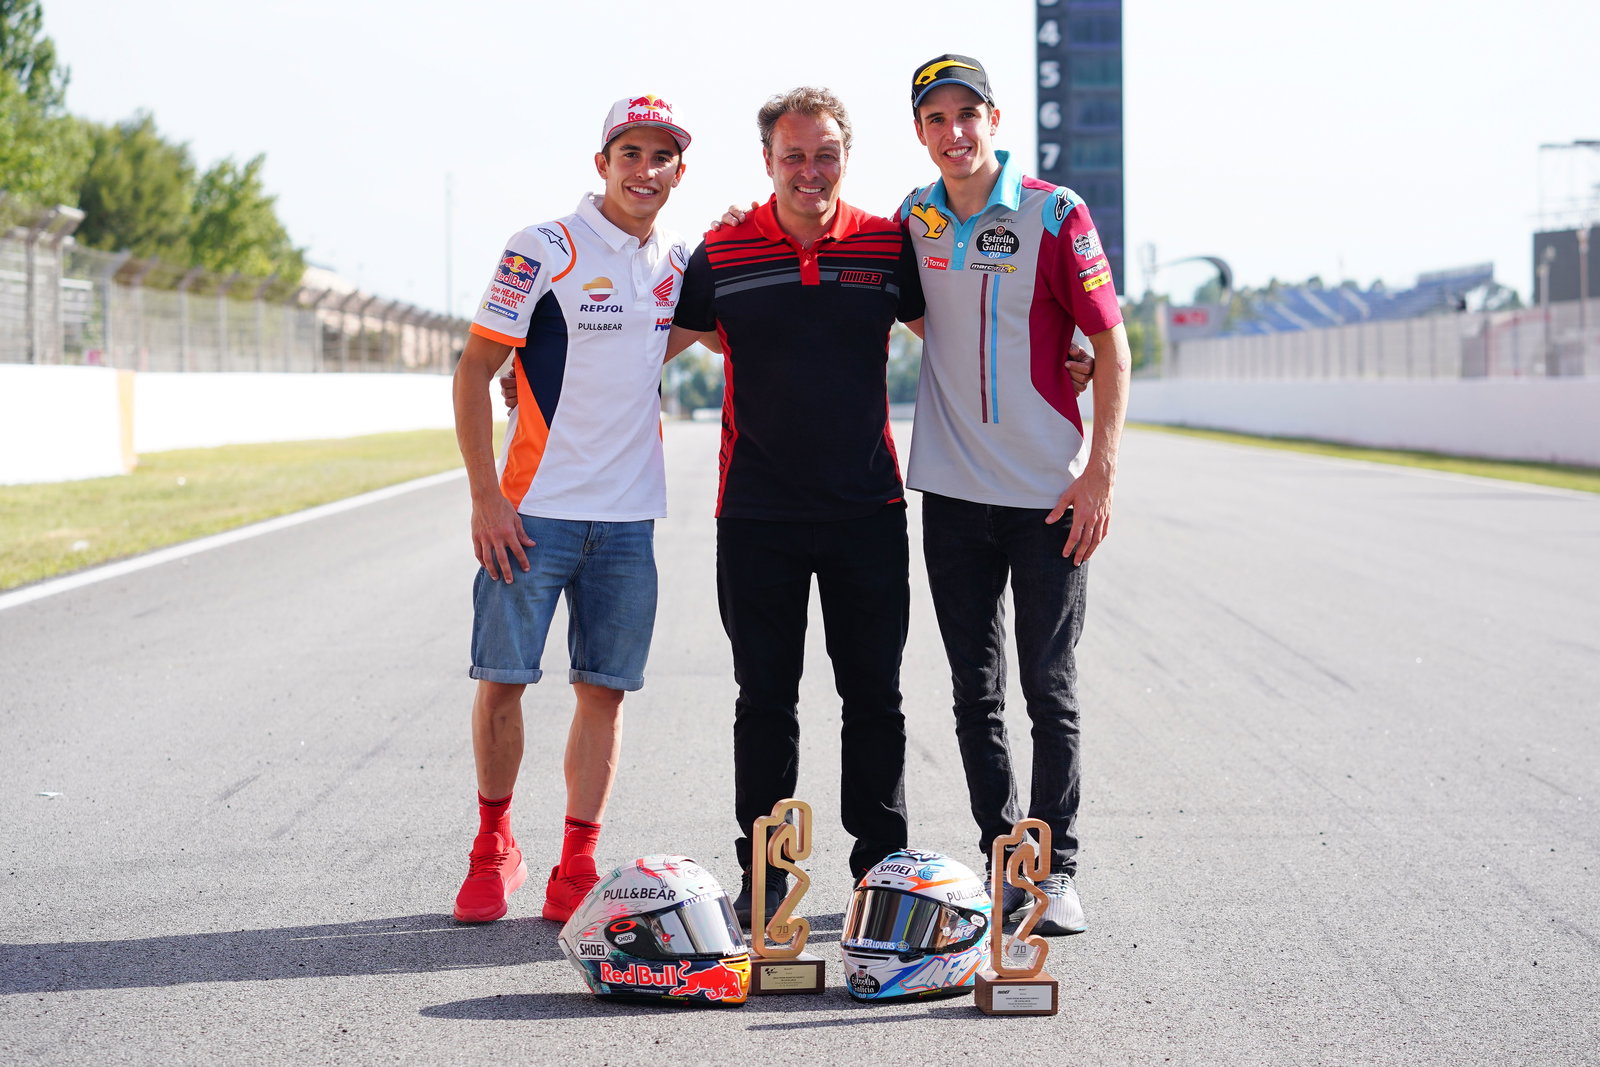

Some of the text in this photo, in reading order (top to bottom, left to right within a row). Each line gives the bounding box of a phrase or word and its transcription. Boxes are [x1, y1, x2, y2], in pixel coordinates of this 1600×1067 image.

[1039, 20, 1061, 47] 4
[1039, 60, 1061, 89] 5
[627, 110, 651, 122] Red
[1040, 101, 1062, 130] 6
[1040, 142, 1061, 170] 7
[981, 233, 1015, 245] Estrella
[982, 242, 1012, 253] Galicia
[511, 273, 533, 293] Bull
[579, 304, 624, 313] REPSOL
[577, 322, 623, 331] PULL&BEAR
[878, 864, 912, 876] SHOEI
[603, 887, 677, 901] PULL&BEAR
[776, 925, 789, 934] 70
[617, 934, 634, 943] SHOEI
[580, 943, 606, 959] SHOEI
[873, 940, 896, 951] LOVERS
[1013, 945, 1027, 954] 70
[600, 962, 678, 987] Red Bull
